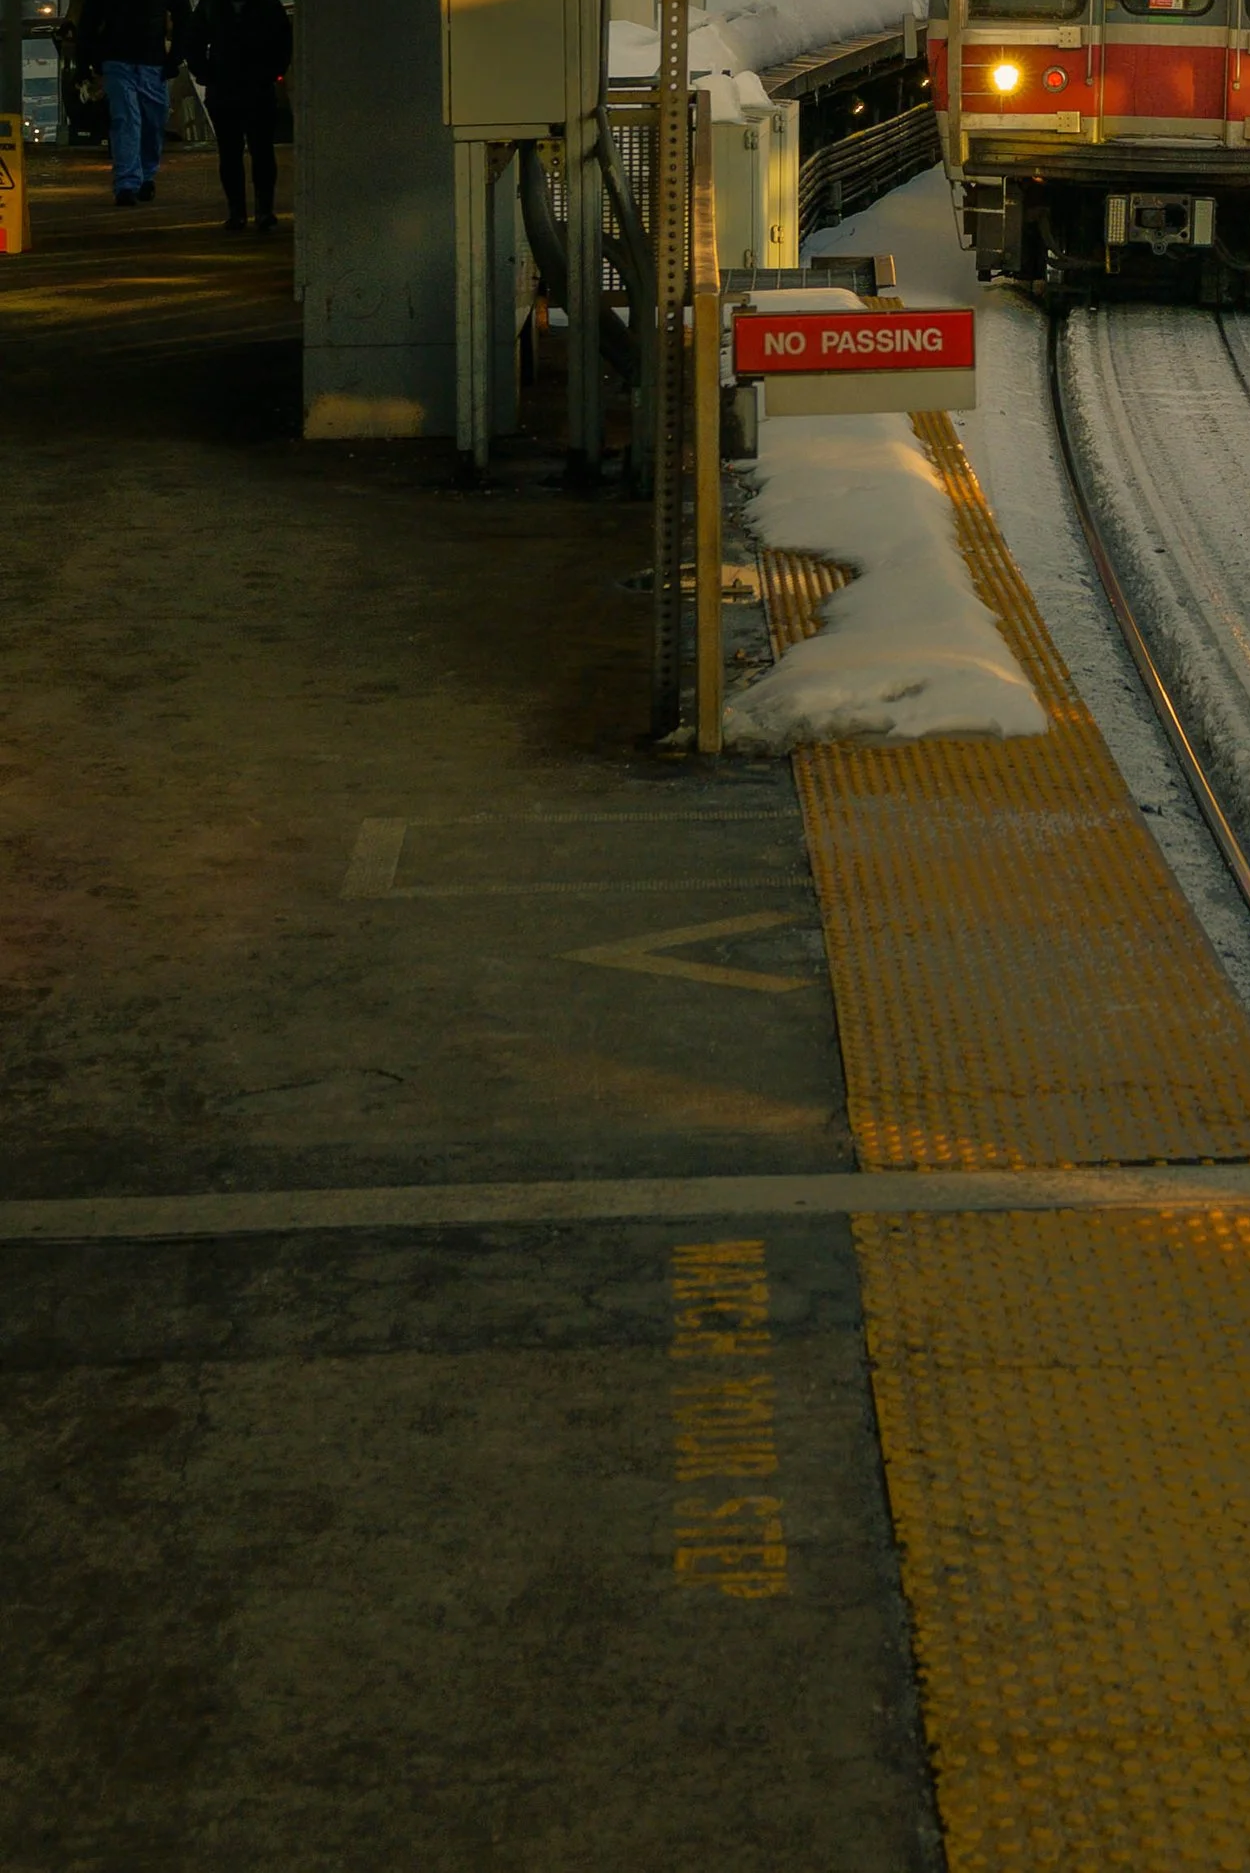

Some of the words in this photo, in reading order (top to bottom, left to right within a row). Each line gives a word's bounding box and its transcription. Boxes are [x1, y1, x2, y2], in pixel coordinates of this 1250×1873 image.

[763, 330, 807, 356] NO
[820, 327, 944, 356] PASSING
[668, 1239, 770, 1357] WATCH
[669, 1373, 778, 1481] YOUR
[673, 1495, 788, 1599] STEP
